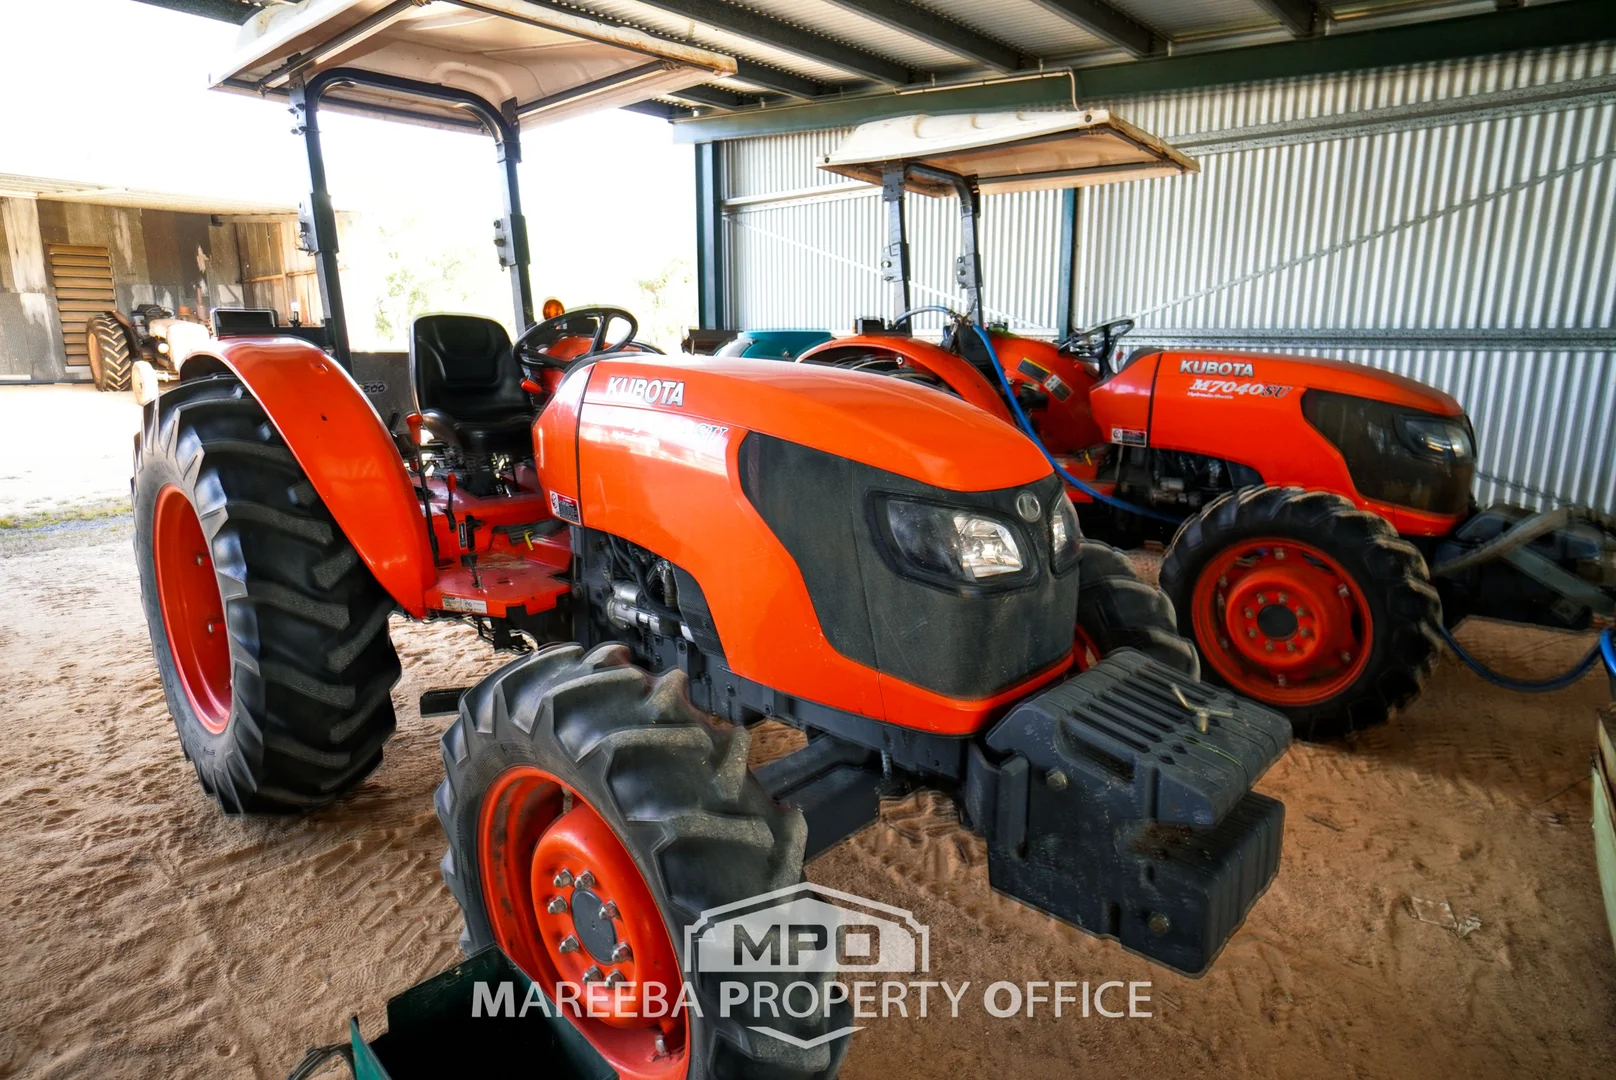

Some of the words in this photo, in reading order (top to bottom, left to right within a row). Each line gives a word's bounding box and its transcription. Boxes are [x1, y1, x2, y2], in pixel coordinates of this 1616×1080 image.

[1179, 360, 1255, 378] KUBOTA
[605, 376, 685, 407] KUBOTA
[1189, 379, 1293, 398] M7040SU
